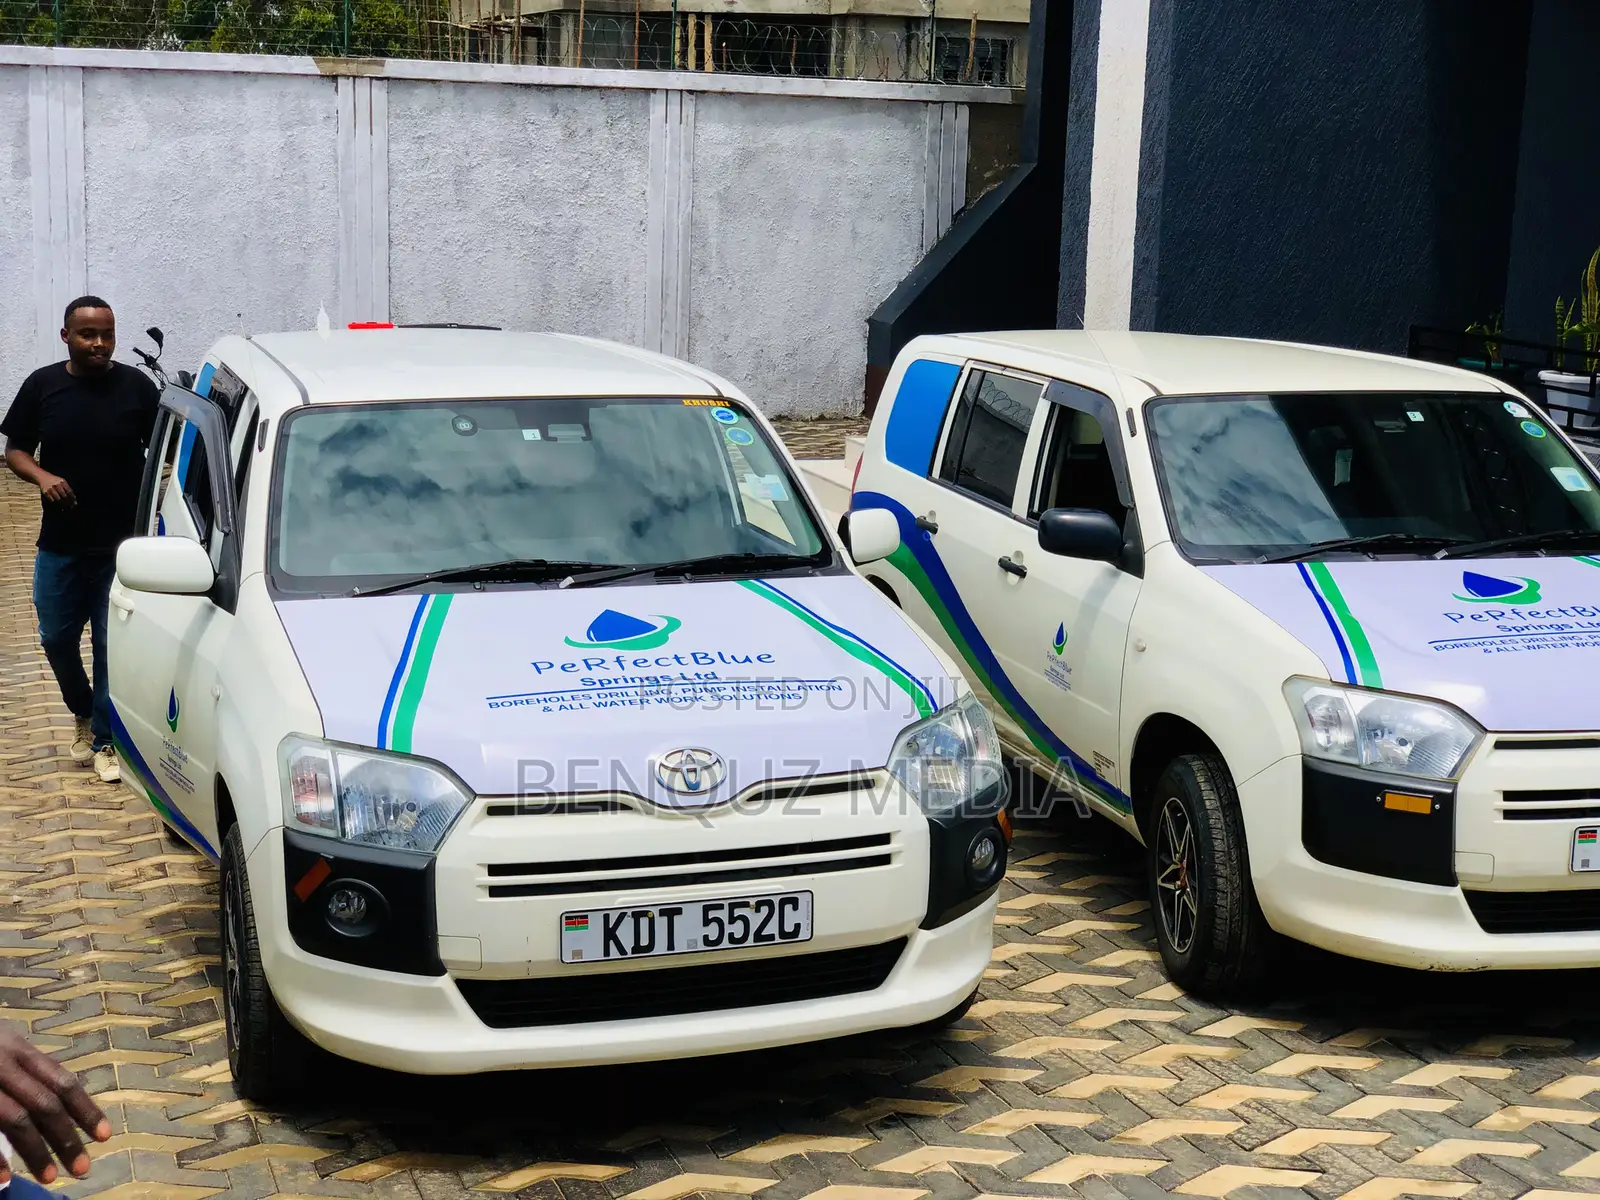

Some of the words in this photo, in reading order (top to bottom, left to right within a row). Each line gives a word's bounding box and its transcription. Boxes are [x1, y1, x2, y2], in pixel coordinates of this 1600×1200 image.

[682, 399, 731, 407] KHUSHI
[1496, 623, 1573, 633] Springs
[1433, 639, 1519, 651] BOREHOLES
[1522, 642, 1572, 650] WATER
[531, 651, 776, 675] PeRfectBlue
[580, 674, 673, 688] Springs
[680, 671, 720, 682] Ltd
[488, 693, 593, 709] BOREHOLES
[597, 687, 678, 700] DRILLING,
[682, 685, 727, 695] PUMP
[731, 684, 843, 693] INSTALLATION
[542, 705, 553, 713] &
[558, 702, 591, 712] ALL
[592, 698, 652, 708] WATER
[654, 696, 706, 706] WORK
[711, 692, 803, 702] SOLUTIONS
[602, 906, 684, 958] KDT
[702, 896, 801, 948] 552C
